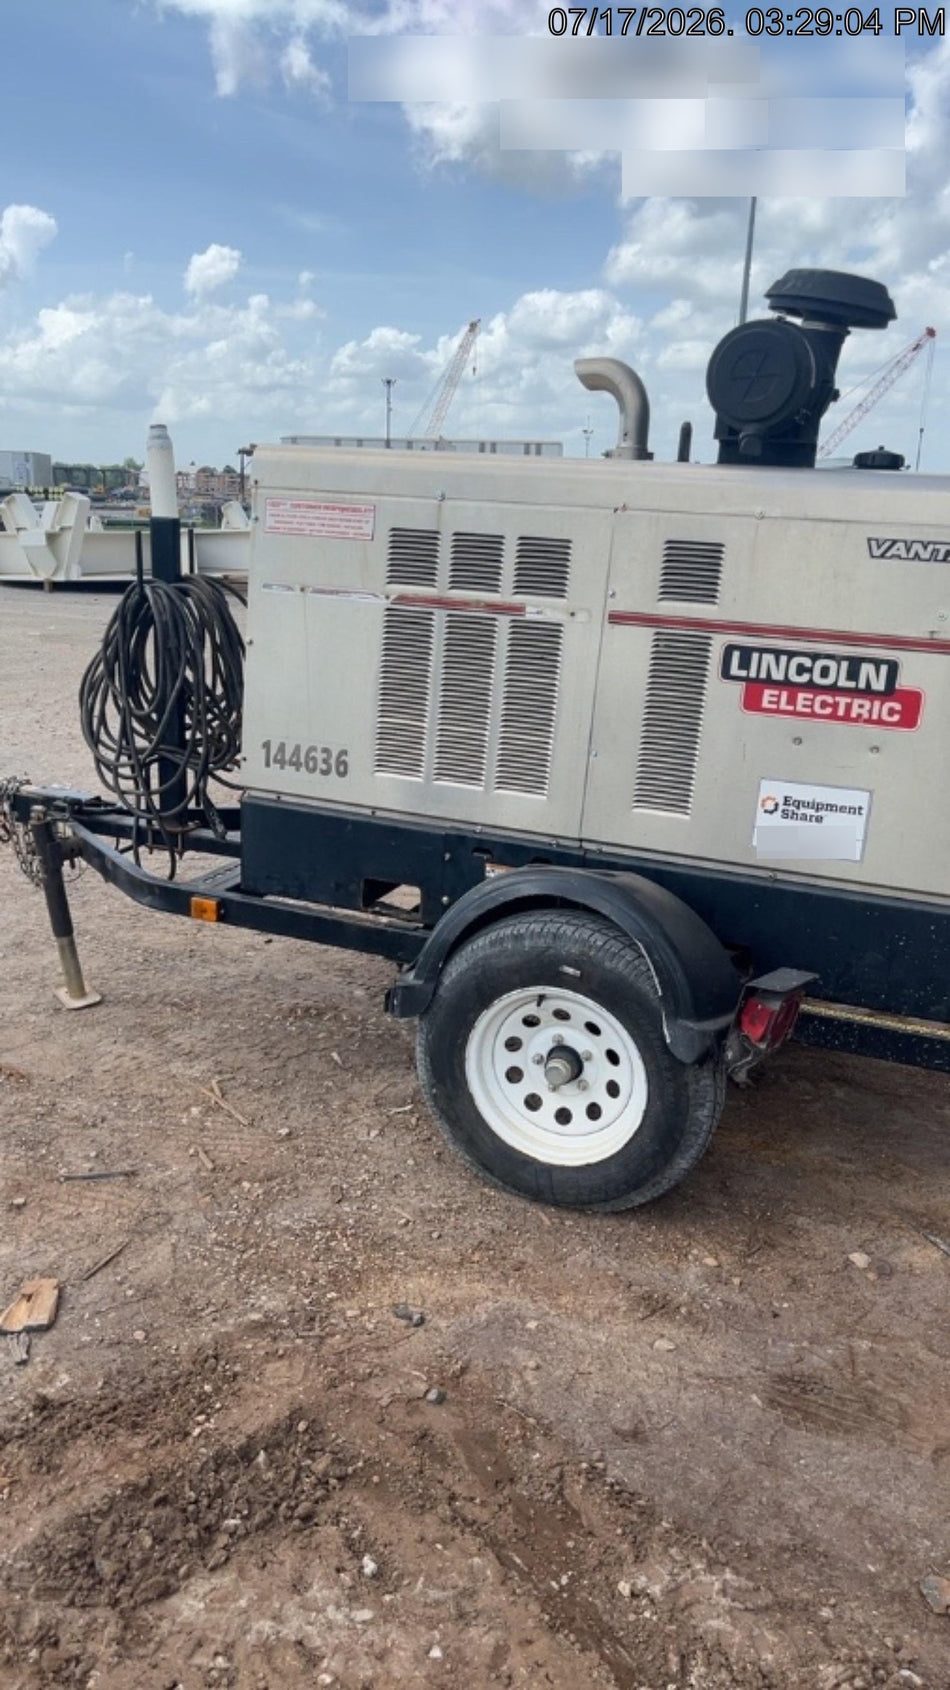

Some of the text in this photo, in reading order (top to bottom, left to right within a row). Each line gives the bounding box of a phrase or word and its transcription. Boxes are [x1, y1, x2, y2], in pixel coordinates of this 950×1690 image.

[867, 537, 950, 562] VANT
[729, 650, 889, 692] LINCOLN
[761, 688, 902, 723] ELECTRIC
[262, 739, 349, 778] 144636
[780, 808, 824, 823] Share
[782, 795, 864, 815] Equipment
